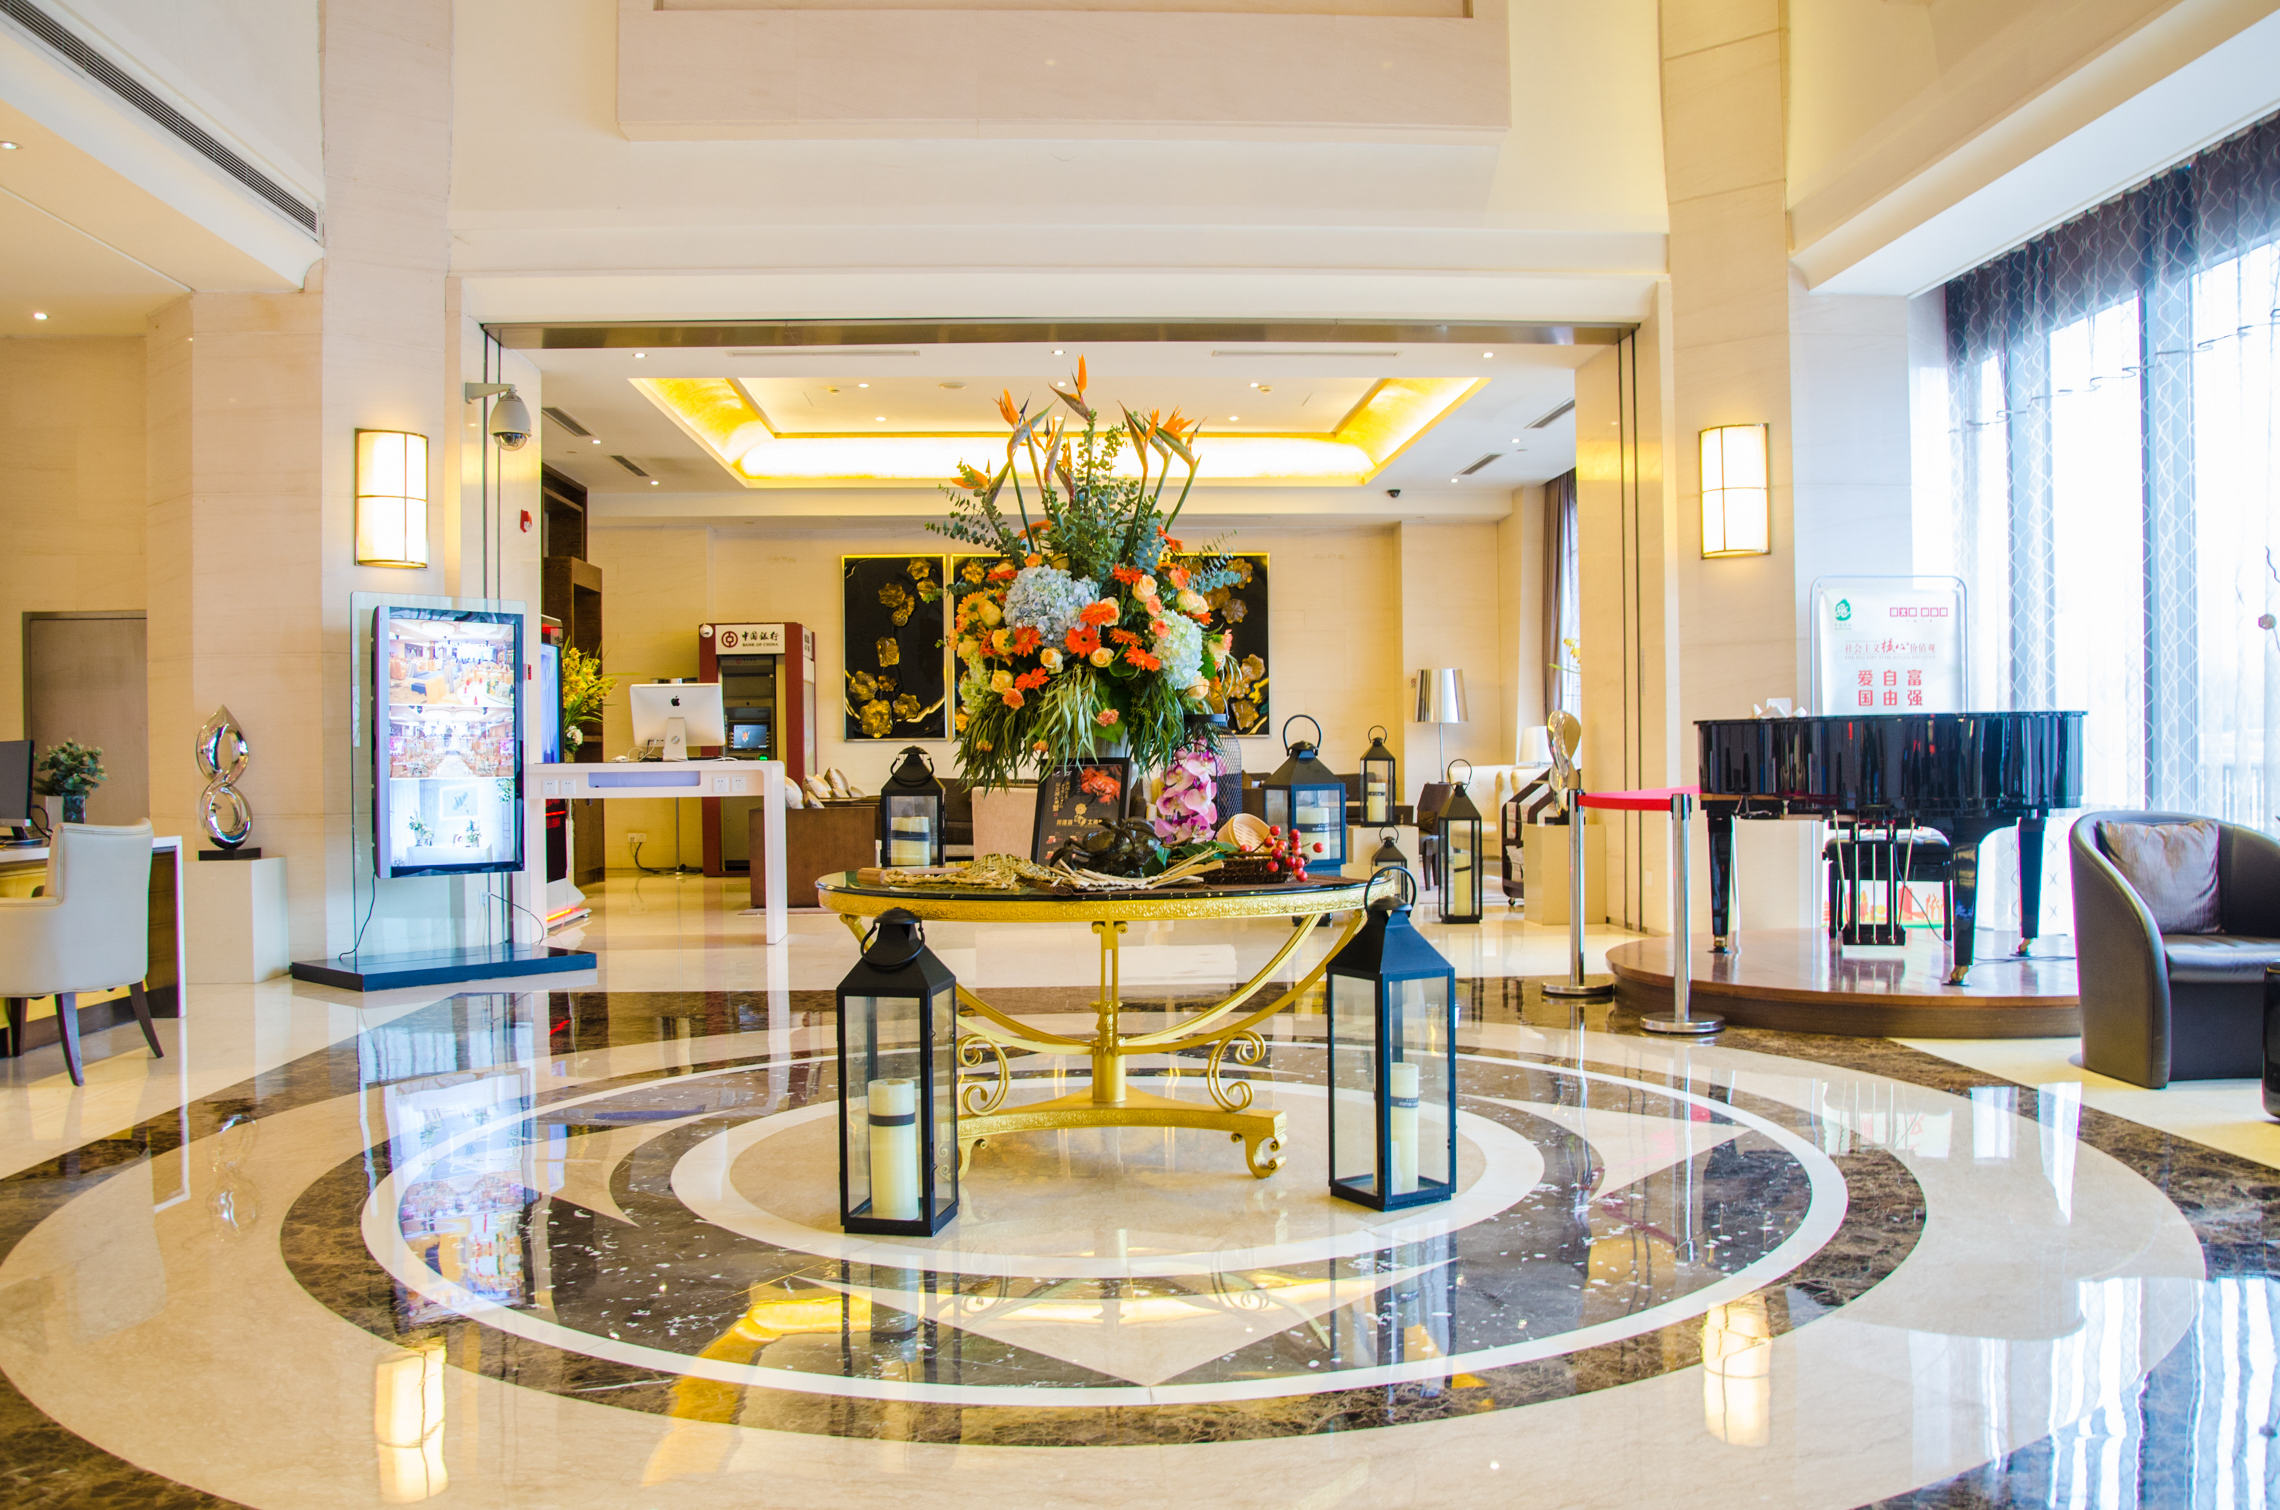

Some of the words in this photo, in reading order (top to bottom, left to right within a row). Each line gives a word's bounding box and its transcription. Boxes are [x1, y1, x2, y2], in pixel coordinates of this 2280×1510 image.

[741, 631, 779, 641] 中国银行
[1845, 638, 1936, 653] 社会主义核心价值观
